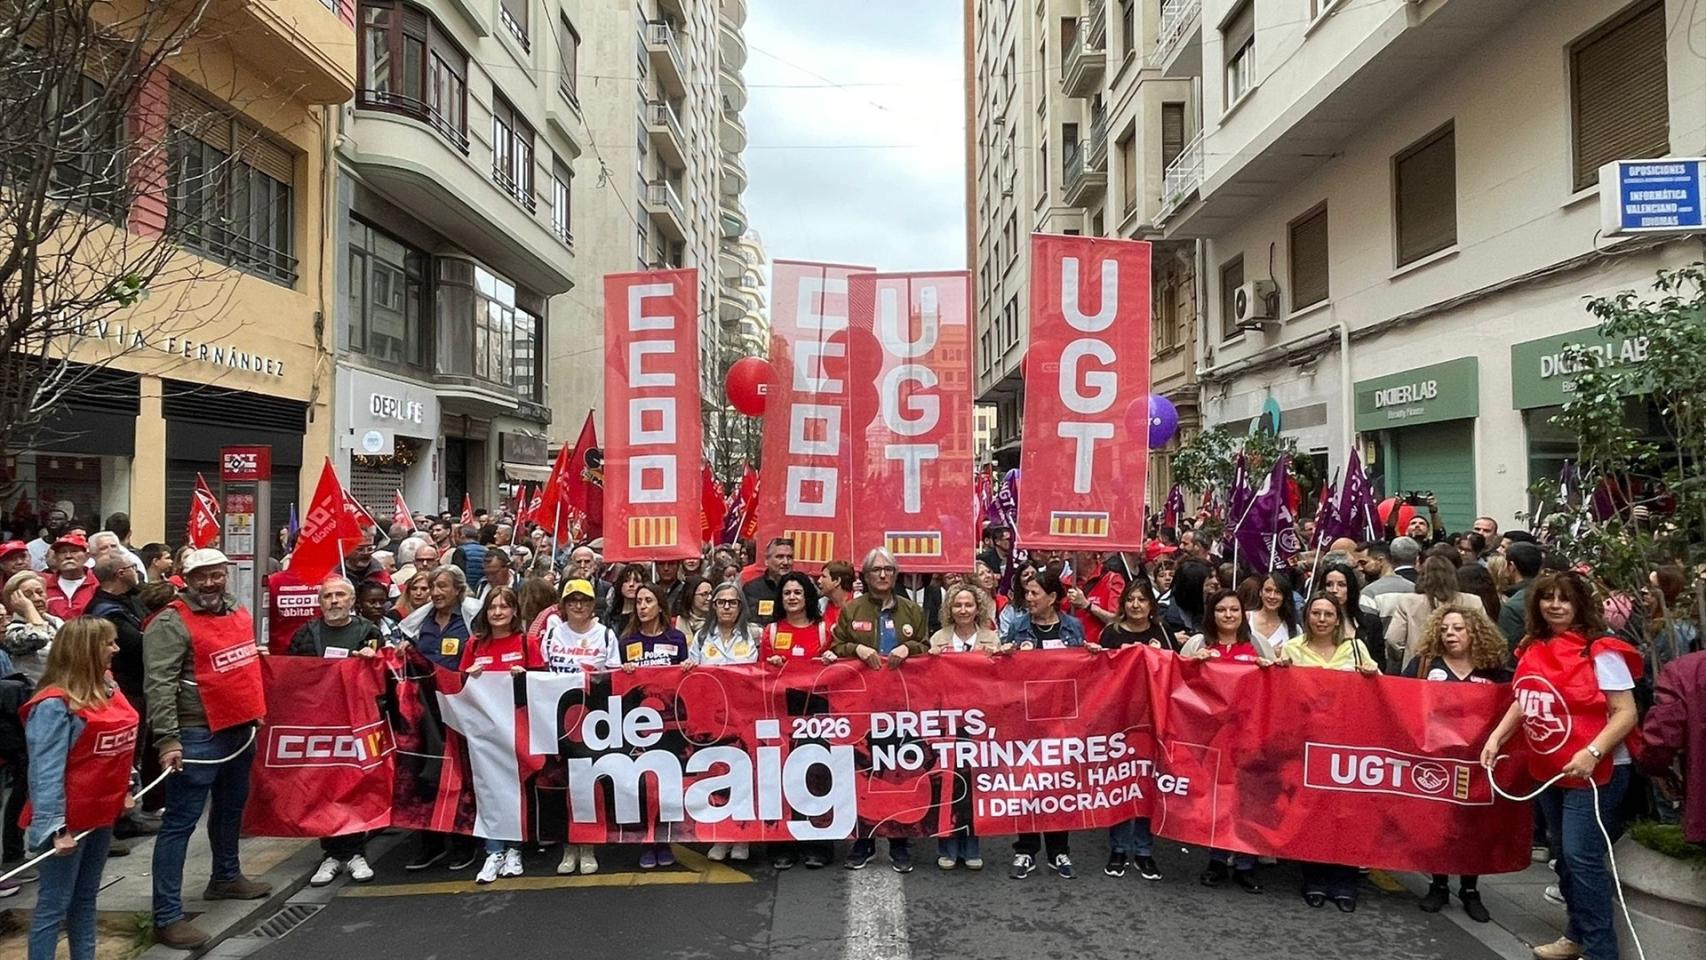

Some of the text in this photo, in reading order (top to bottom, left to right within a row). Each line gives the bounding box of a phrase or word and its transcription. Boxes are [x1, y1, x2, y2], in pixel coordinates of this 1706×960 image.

[1629, 165, 1685, 176] OPOSICIONES
[1626, 203, 1677, 214] VALENCIANO
[1630, 189, 1687, 201] INFORMÁTICA
[164, 336, 284, 377] FERNÁNDEZ
[1057, 257, 1118, 493] UGT
[1413, 380, 1437, 401] LAB
[628, 283, 677, 503] CCOO
[880, 286, 940, 513] UGT
[582, 696, 664, 751] de
[792, 718, 851, 739] 2026
[871, 709, 996, 739] DRETS,
[872, 732, 1136, 771] NO TRINXERES.
[567, 719, 857, 840] maig
[977, 760, 1190, 796] SALARIS, HABITGE
[1331, 753, 1411, 787] UGT
[979, 783, 1143, 817] I DEMOCRÀCIA
